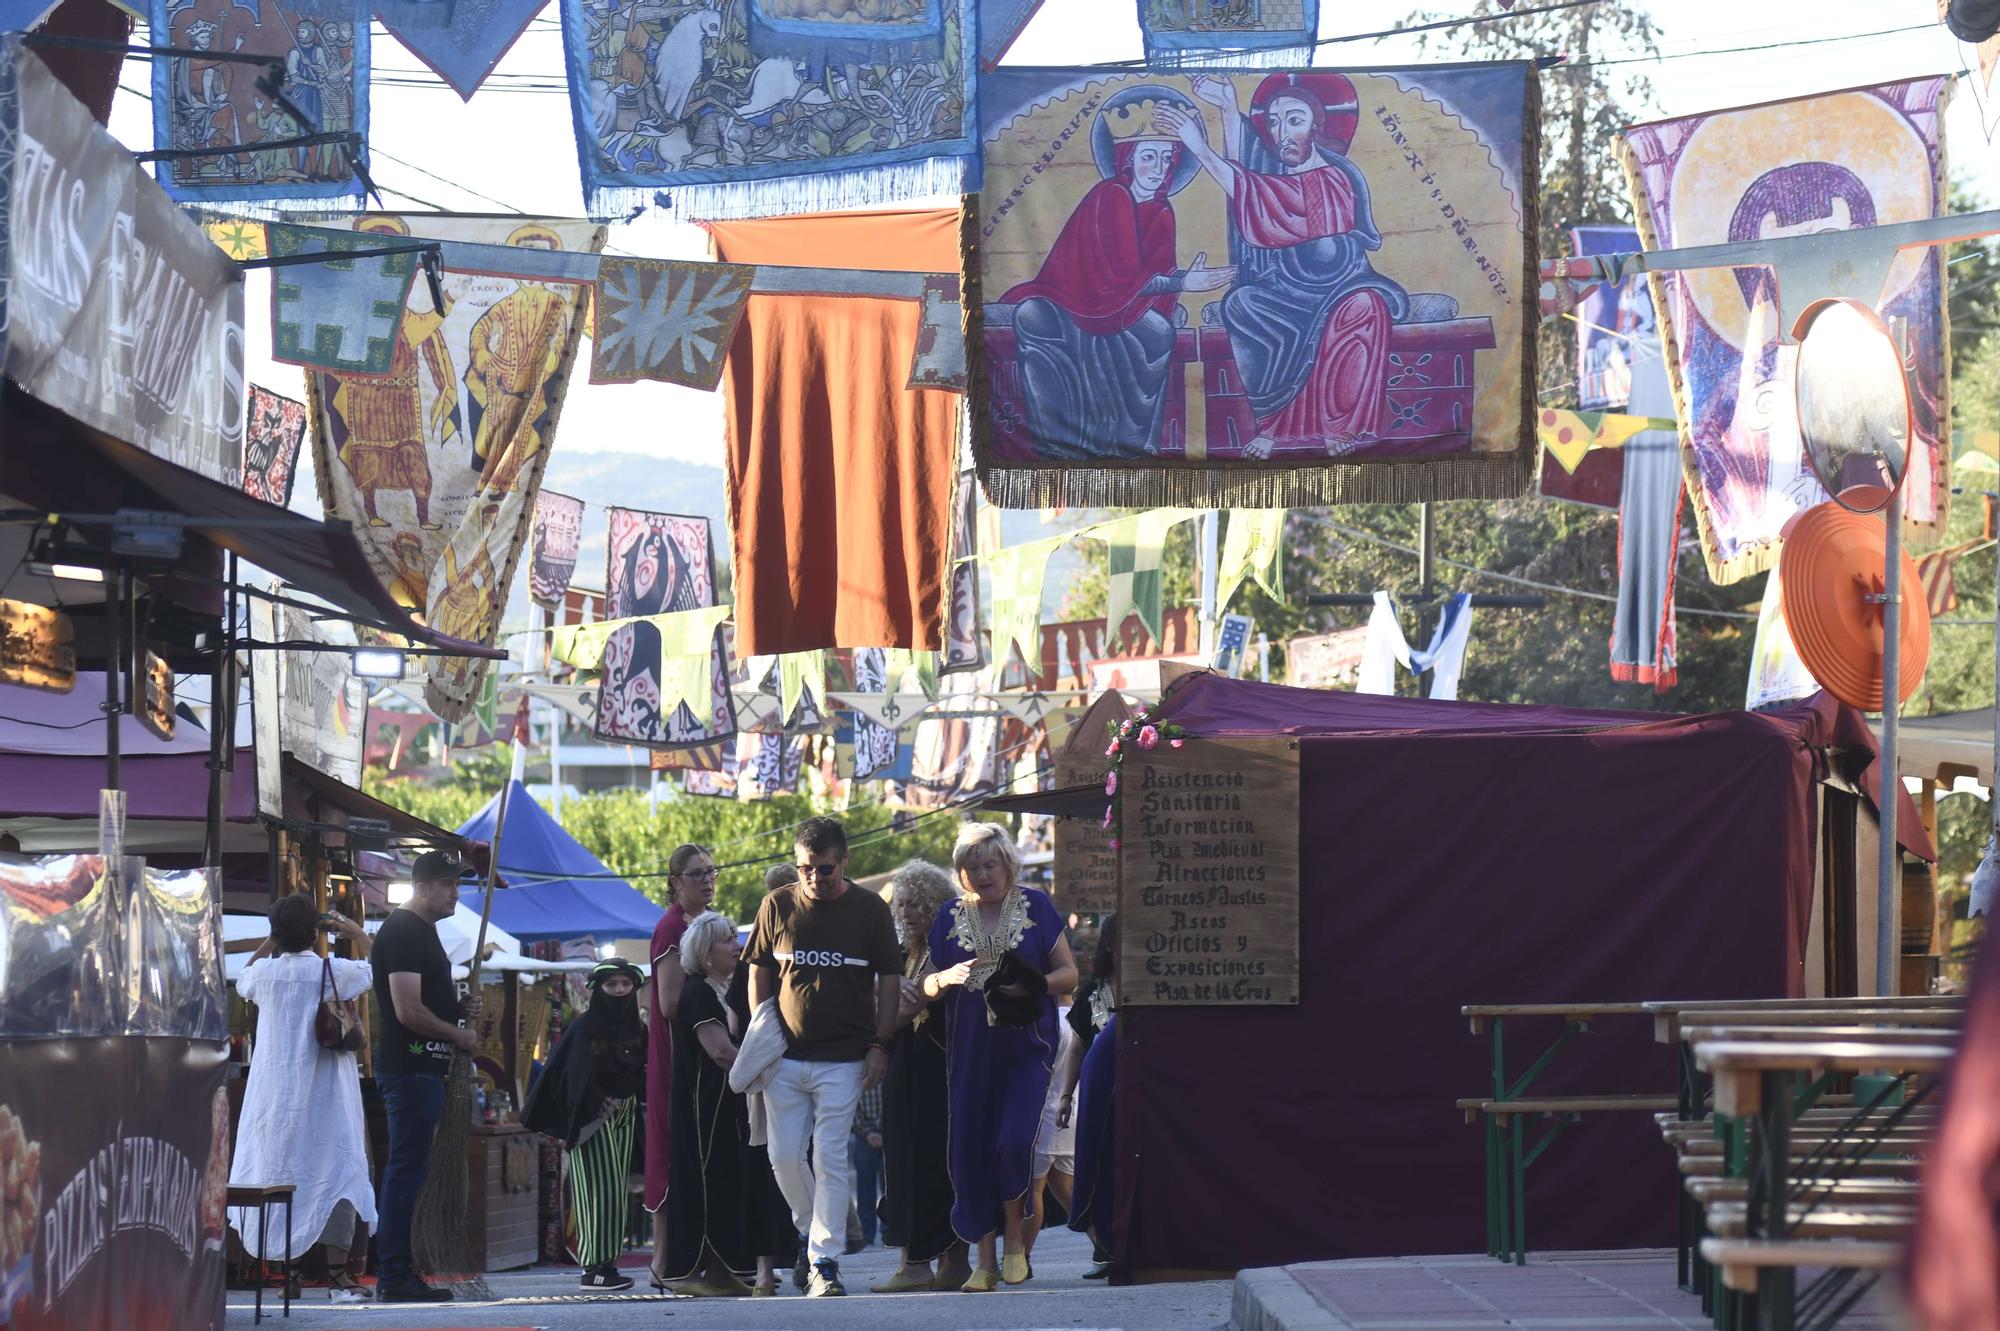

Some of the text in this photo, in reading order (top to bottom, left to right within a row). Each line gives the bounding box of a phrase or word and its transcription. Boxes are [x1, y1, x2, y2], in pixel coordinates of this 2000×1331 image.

[1141, 766, 1243, 788] Asistencia
[1140, 792, 1240, 813] Sanitaria
[1153, 860, 1265, 882] Atracciones
[1140, 884, 1205, 907] Torneos
[1169, 911, 1227, 931] Aseos
[1145, 931, 1247, 953] Oficios y
[795, 950, 842, 966] BOSS
[1145, 955, 1265, 976] Exposiciones
[1194, 983, 1211, 1000] de
[1216, 982, 1232, 999] la
[1233, 979, 1272, 1000] Cruz
